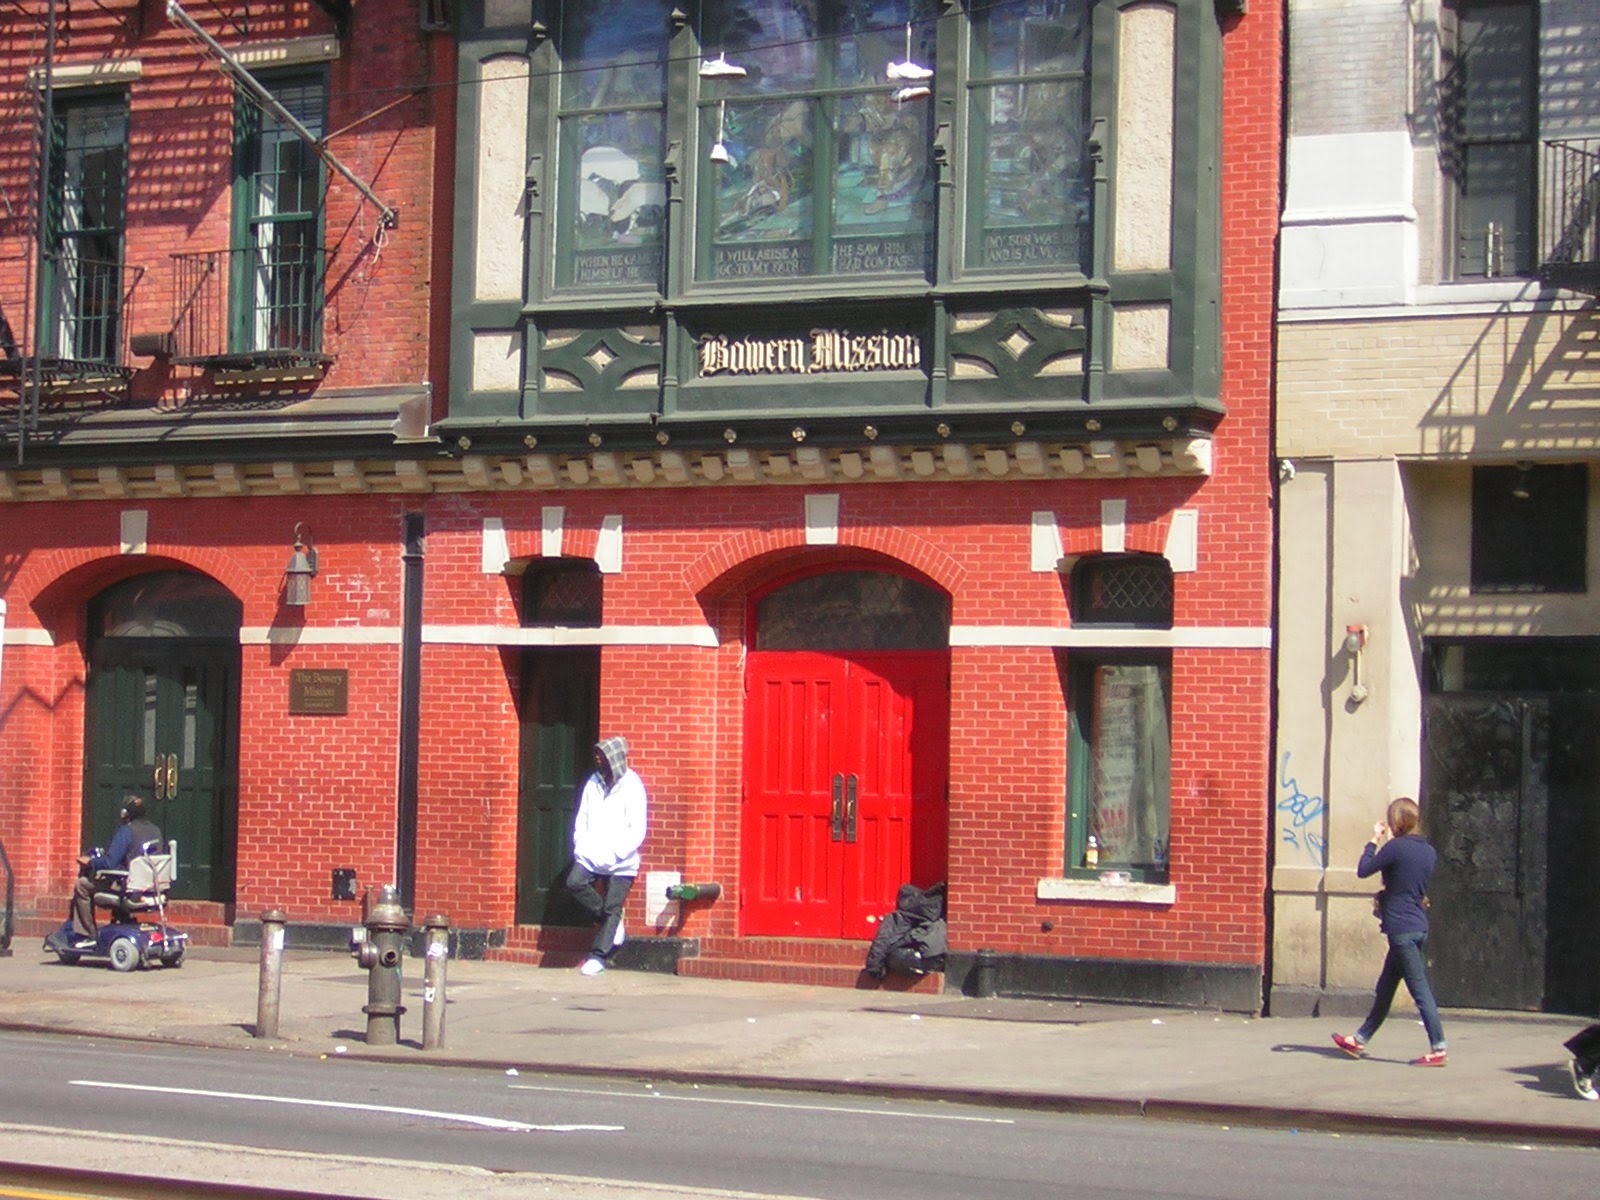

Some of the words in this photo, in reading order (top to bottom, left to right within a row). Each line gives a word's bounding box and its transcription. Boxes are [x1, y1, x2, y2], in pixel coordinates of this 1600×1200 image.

[727, 249, 754, 262] WILL
[756, 248, 790, 260] ARISE
[840, 244, 853, 257] HE
[856, 243, 880, 256] SAW
[579, 255, 609, 268] WHEN
[753, 260, 769, 274] MY
[700, 333, 805, 377] Bowery
[808, 328, 920, 374] Mission
[295, 672, 311, 683] The
